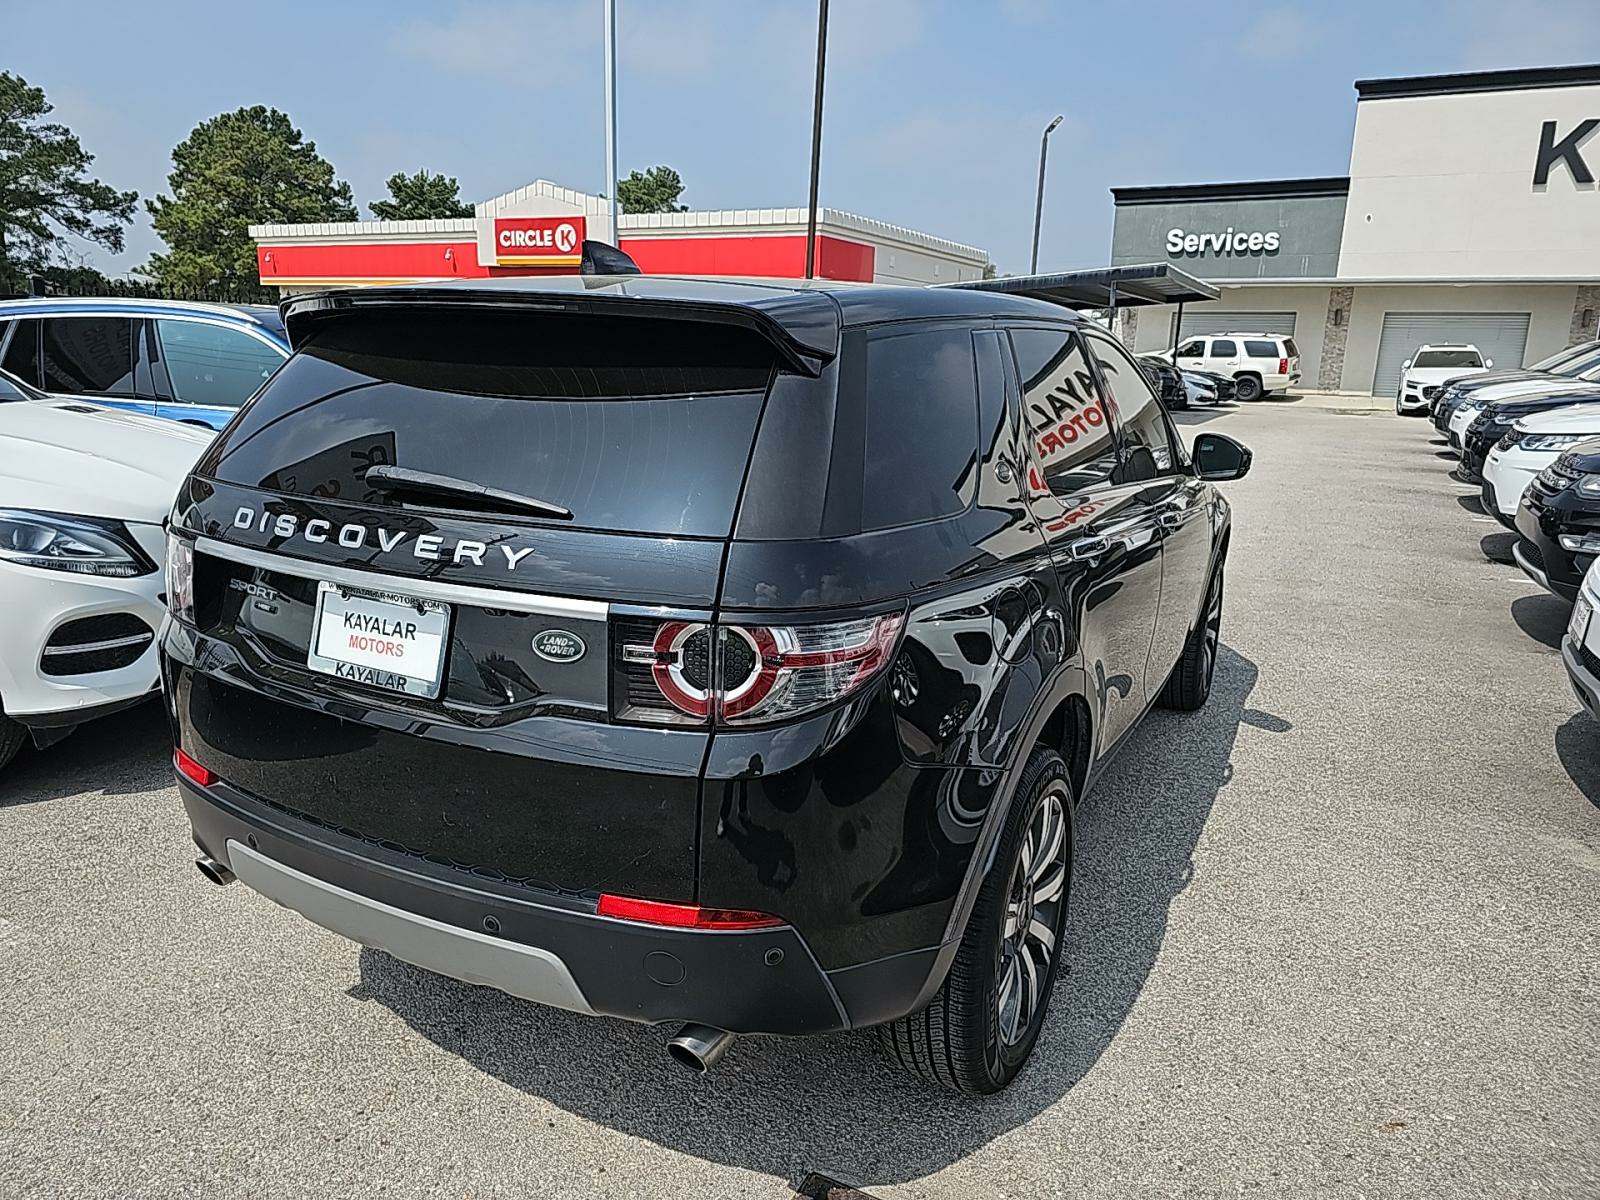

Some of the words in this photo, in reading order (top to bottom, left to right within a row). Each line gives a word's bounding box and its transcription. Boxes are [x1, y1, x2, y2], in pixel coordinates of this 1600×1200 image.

[500, 229, 553, 248] CIRCLE
[558, 226, 576, 251] K
[1165, 227, 1280, 254] Services
[233, 506, 535, 571] DISCOVERY
[229, 578, 278, 600] SPORT
[343, 611, 417, 641] KAYALAR
[348, 634, 405, 658] MOTORS
[543, 635, 569, 647] LAND
[543, 644, 576, 656] ROVER
[334, 661, 408, 692] KAYALAR
